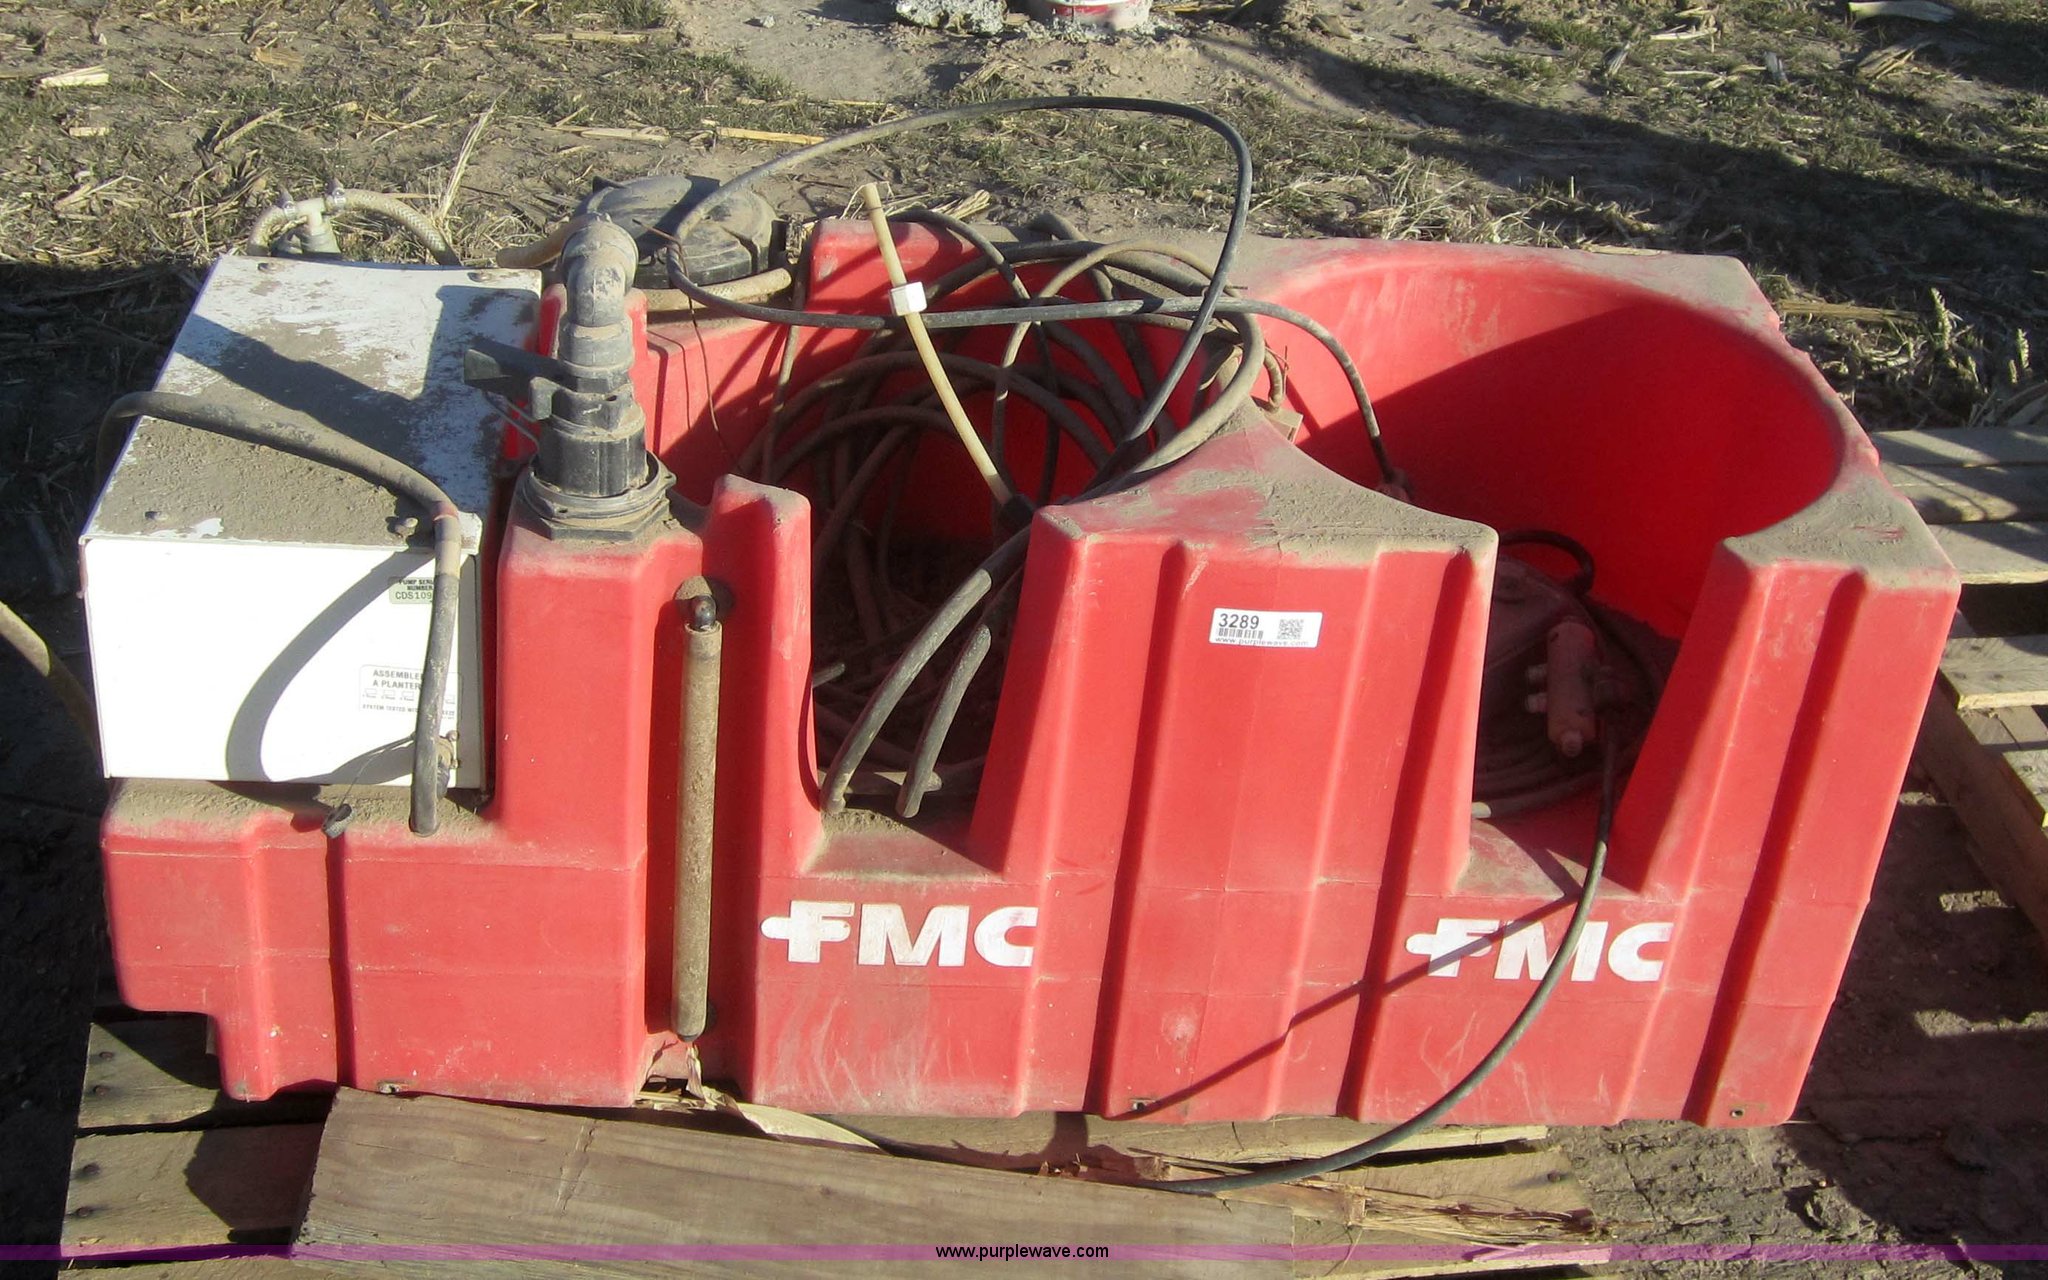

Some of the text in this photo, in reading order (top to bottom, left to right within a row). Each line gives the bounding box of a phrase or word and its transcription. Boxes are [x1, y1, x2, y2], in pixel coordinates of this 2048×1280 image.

[395, 591, 432, 600] CDS109
[1218, 613, 1260, 630] 3289
[372, 669, 423, 681] ASSEMBLE
[380, 681, 421, 690] PLANTER
[760, 900, 1039, 967] FMC
[1405, 917, 1674, 982] FMC
